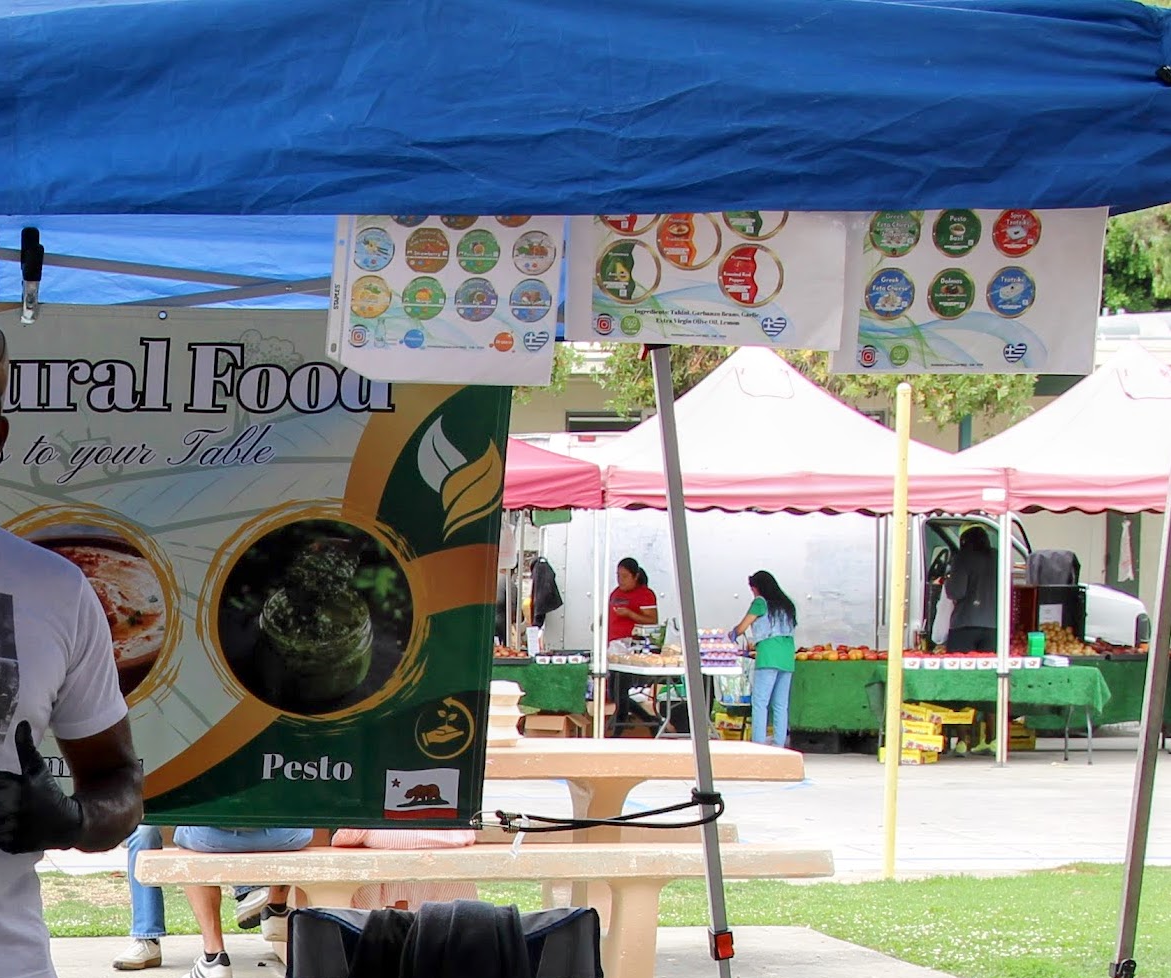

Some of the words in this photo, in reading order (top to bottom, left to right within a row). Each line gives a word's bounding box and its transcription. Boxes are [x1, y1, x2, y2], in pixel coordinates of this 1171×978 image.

[21, 433, 58, 466] to
[56, 442, 158, 485] your
[166, 423, 276, 467] Table
[260, 752, 354, 783] Pesto
